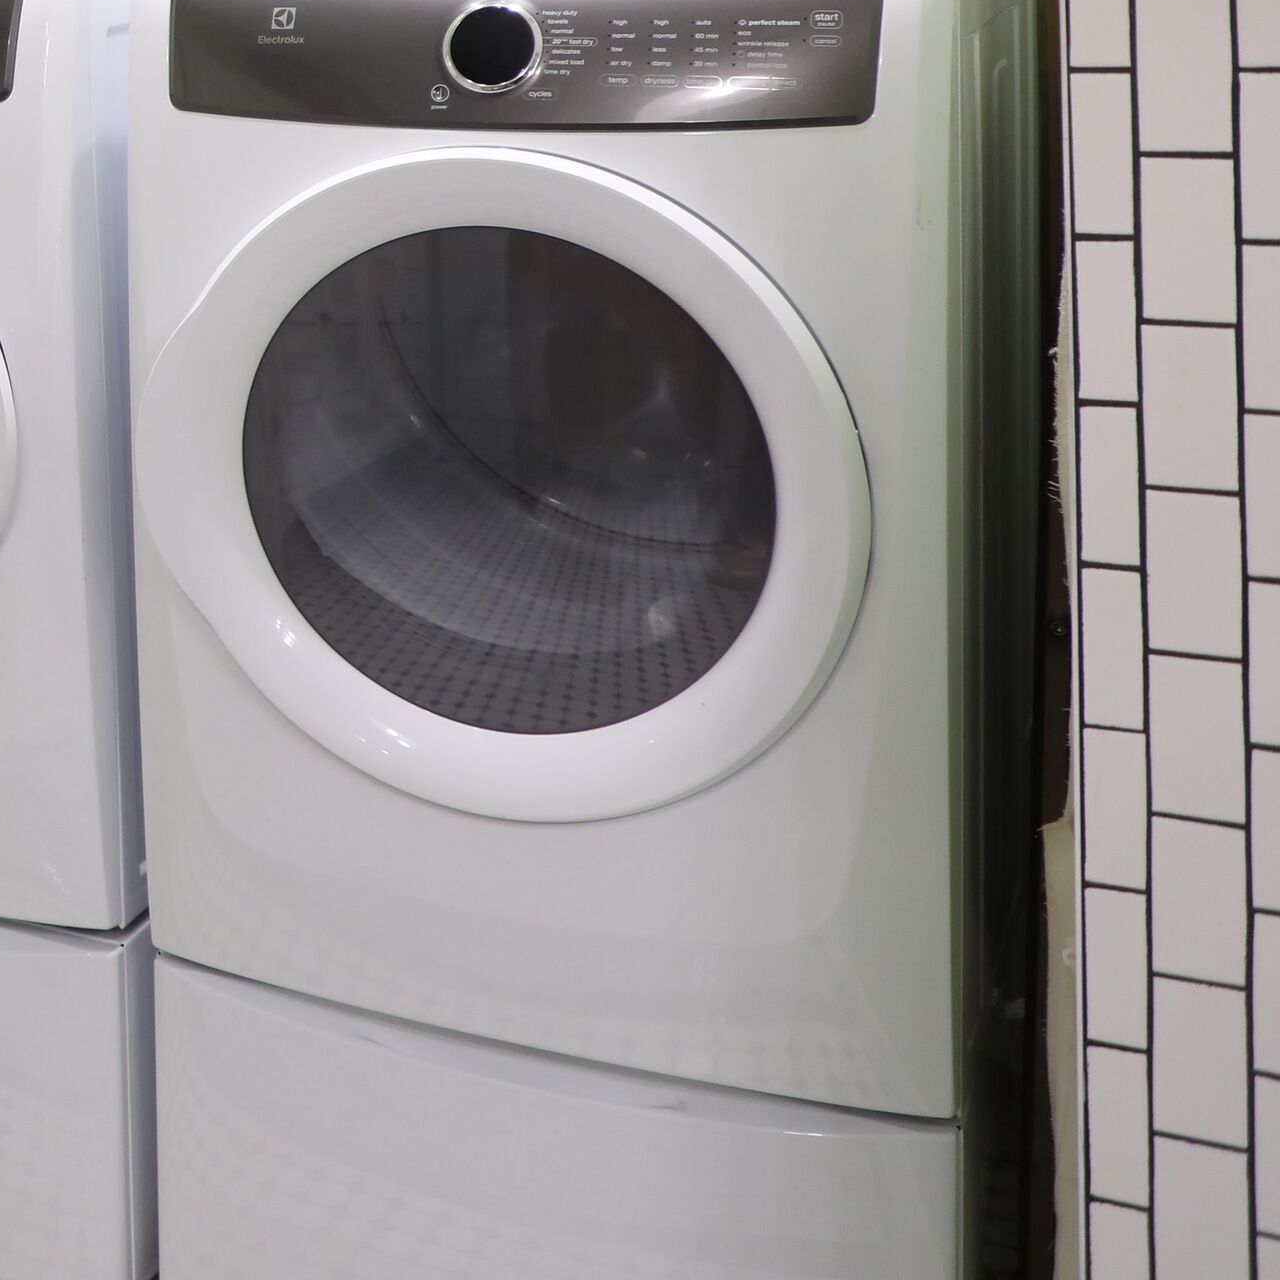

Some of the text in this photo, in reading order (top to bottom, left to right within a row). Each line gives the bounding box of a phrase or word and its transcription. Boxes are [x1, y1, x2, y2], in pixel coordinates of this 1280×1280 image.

[815, 13, 839, 21] start
[258, 35, 304, 44] Electrolux
[644, 77, 675, 85] dryness
[529, 90, 552, 98] cycles
